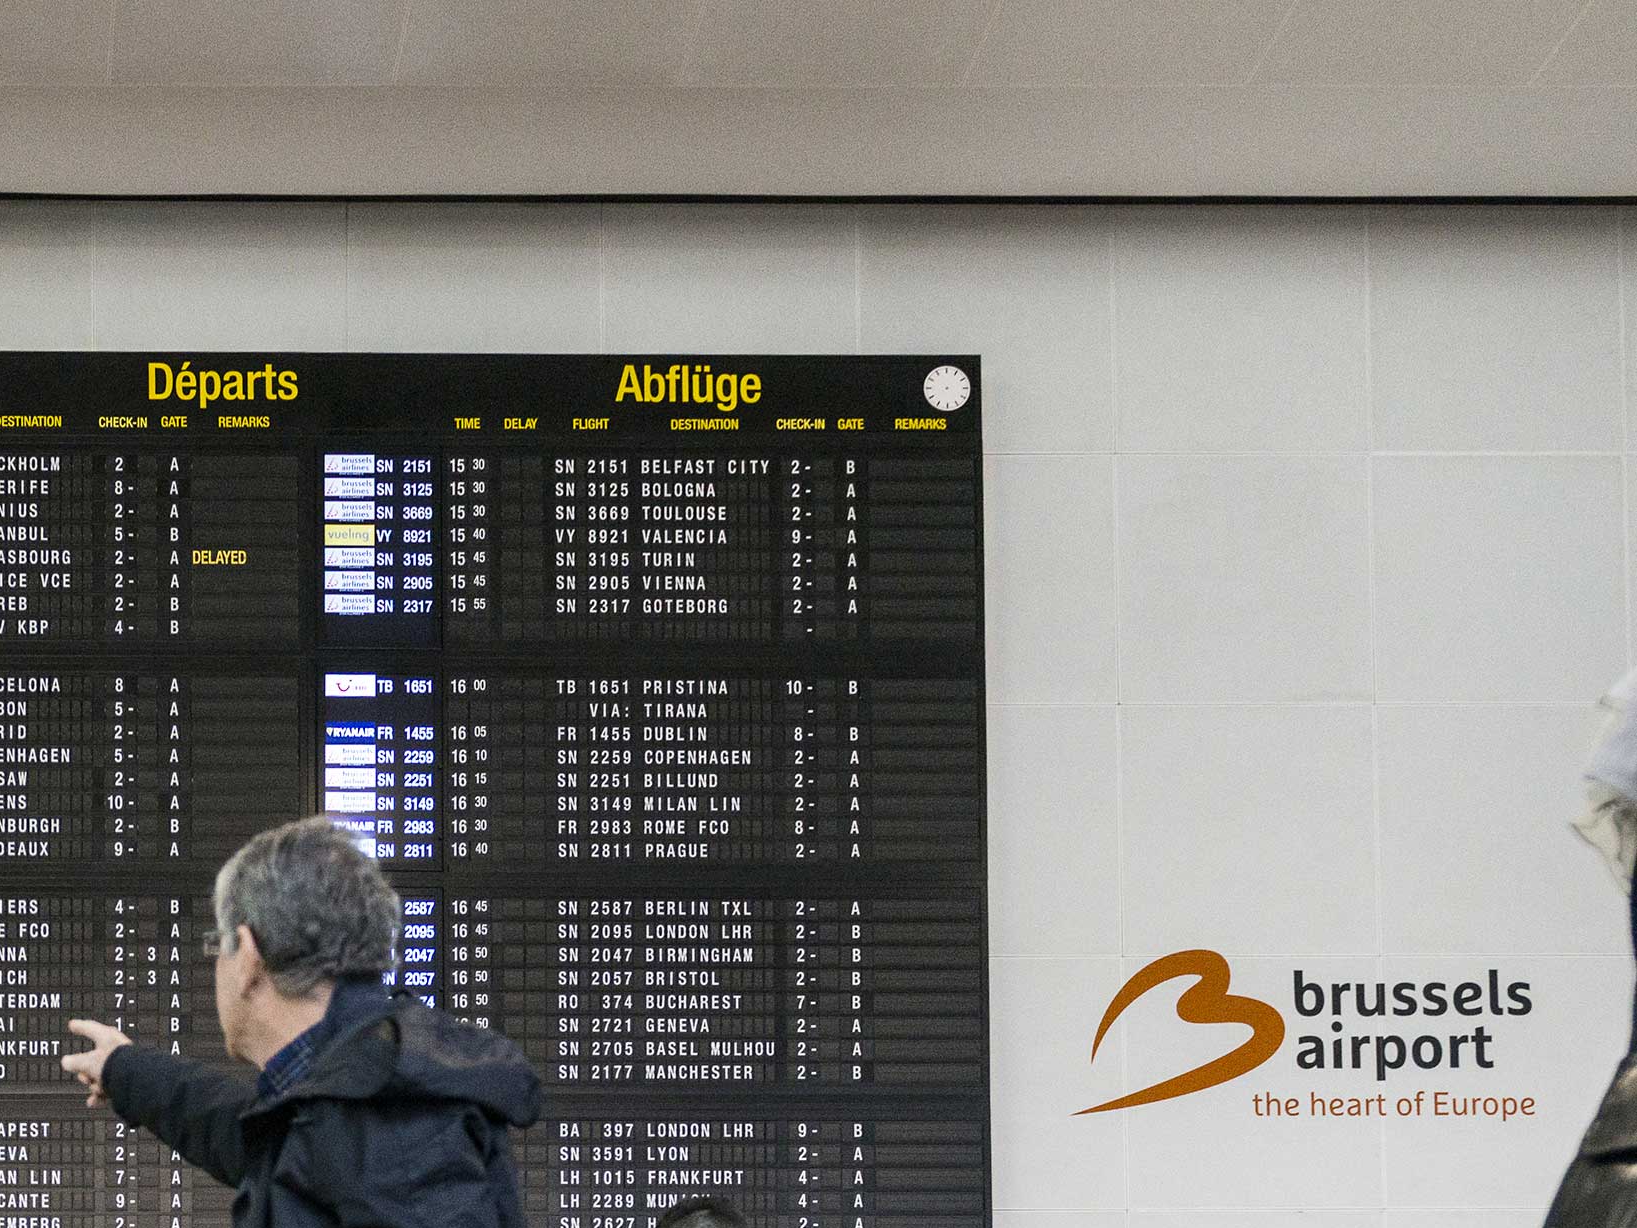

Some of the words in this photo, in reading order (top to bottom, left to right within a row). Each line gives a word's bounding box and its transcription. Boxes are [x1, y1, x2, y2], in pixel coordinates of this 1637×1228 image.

[148, 362, 299, 408] Départs
[615, 364, 762, 411] Abflüge
[98, 416, 148, 428] CHECK-IN
[160, 415, 188, 428] GATE
[218, 415, 270, 428] REMARKS
[454, 417, 481, 430] TIME
[504, 417, 538, 430] DELAY
[572, 418, 610, 430] FLIGHT
[670, 418, 739, 431] DESTINATION
[776, 418, 826, 430] CHECK-IN
[837, 418, 865, 430] GATE
[894, 418, 947, 430] REMARKS
[341, 456, 373, 464] brussels
[341, 463, 370, 471] airlines
[641, 459, 715, 475] BELFAST
[727, 459, 769, 475] CITY
[641, 505, 727, 521] TOULOUSE
[327, 528, 371, 543] vueling
[555, 528, 576, 543] VY
[588, 529, 628, 544] 8921
[641, 529, 727, 544] VALENCIA
[192, 550, 247, 565] DELAYED
[40, 573, 71, 588] VCE
[642, 598, 728, 614] GOTEBORG
[17, 619, 49, 635] KBP
[643, 703, 707, 718] TIRANA
[643, 726, 707, 741] DUBLIN
[644, 773, 718, 788] BILLUND
[644, 796, 697, 811] MILAN
[710, 796, 741, 812] LIN
[645, 843, 708, 858] PRAGUE
[645, 900, 709, 916] BERLIN
[721, 901, 752, 916] TXL
[19, 922, 50, 938] FCO
[645, 947, 753, 963] BIRMINGHAM
[645, 971, 720, 986] BRISTOL
[1293, 969, 1533, 1017] brussels
[645, 1017, 710, 1033] GENEVA
[646, 1041, 699, 1056] BASEL
[710, 1041, 775, 1057] MULHOU
[1295, 1021, 1495, 1081] airport
[1252, 1093, 1300, 1117] the
[1310, 1093, 1387, 1117] heart
[1396, 1091, 1425, 1117] of
[1433, 1092, 1536, 1121] Europe
[647, 1122, 710, 1138] LONDON
[723, 1123, 754, 1138] LHR
[30, 1169, 61, 1185] LIN
